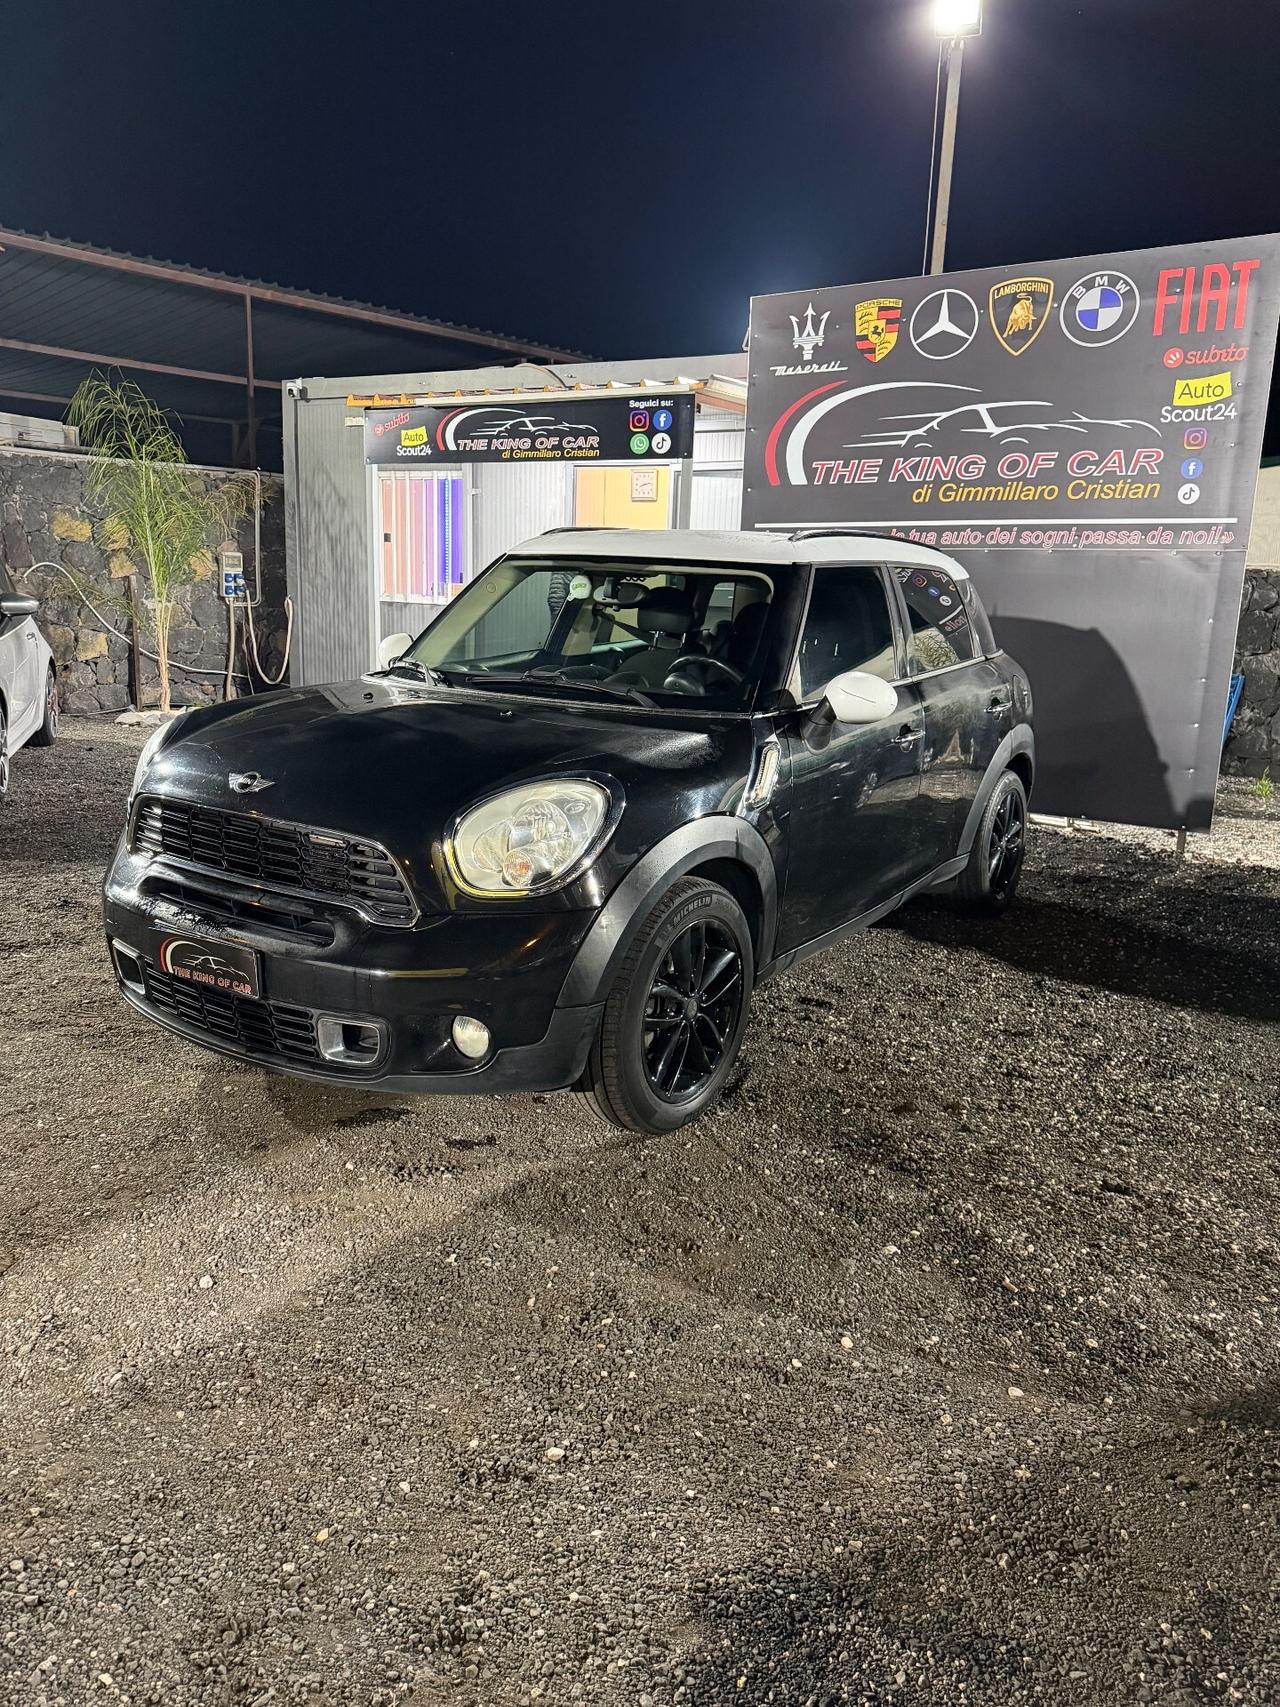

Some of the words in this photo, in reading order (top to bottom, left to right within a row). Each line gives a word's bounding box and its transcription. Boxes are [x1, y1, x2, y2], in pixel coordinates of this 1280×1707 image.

[994, 282, 1049, 299] LAMBORGHINI
[1072, 275, 1131, 299] BMW
[856, 300, 901, 311] PORSCHE
[1152, 259, 1261, 336] FIAT
[1185, 343, 1250, 365] subito
[769, 361, 848, 377] Maserati
[1178, 383, 1224, 400] Auto
[629, 399, 659, 410] Seguici
[1160, 403, 1238, 423] Scout24
[384, 412, 410, 432] subito
[403, 432, 424, 442] Auto
[457, 439, 489, 451] THE
[491, 437, 532, 450] KING
[535, 437, 559, 449] OF
[562, 435, 600, 449] CAR
[396, 444, 432, 457] Scout24
[502, 449, 510, 459] di
[512, 448, 562, 459] Gimmillaro
[564, 448, 600, 458] Cristian
[812, 459, 883, 485] THE
[888, 454, 987, 483] KING
[997, 451, 1059, 479] OF
[1067, 448, 1164, 477] CAR
[912, 483, 934, 503] di
[938, 480, 1059, 503] Gimmillaro
[1067, 479, 1162, 500] Cristian
[908, 528, 938, 545] tua
[940, 528, 982, 545] auto
[985, 526, 1018, 545] dei
[1020, 526, 1077, 548] sogni
[1078, 530, 1142, 548] passa
[1146, 526, 1174, 545] da
[673, 895, 712, 923] MICHELIN
[173, 966, 191, 979] THE
[192, 970, 215, 985] KING
[217, 977, 231, 988] OF
[232, 981, 252, 995] CAR
